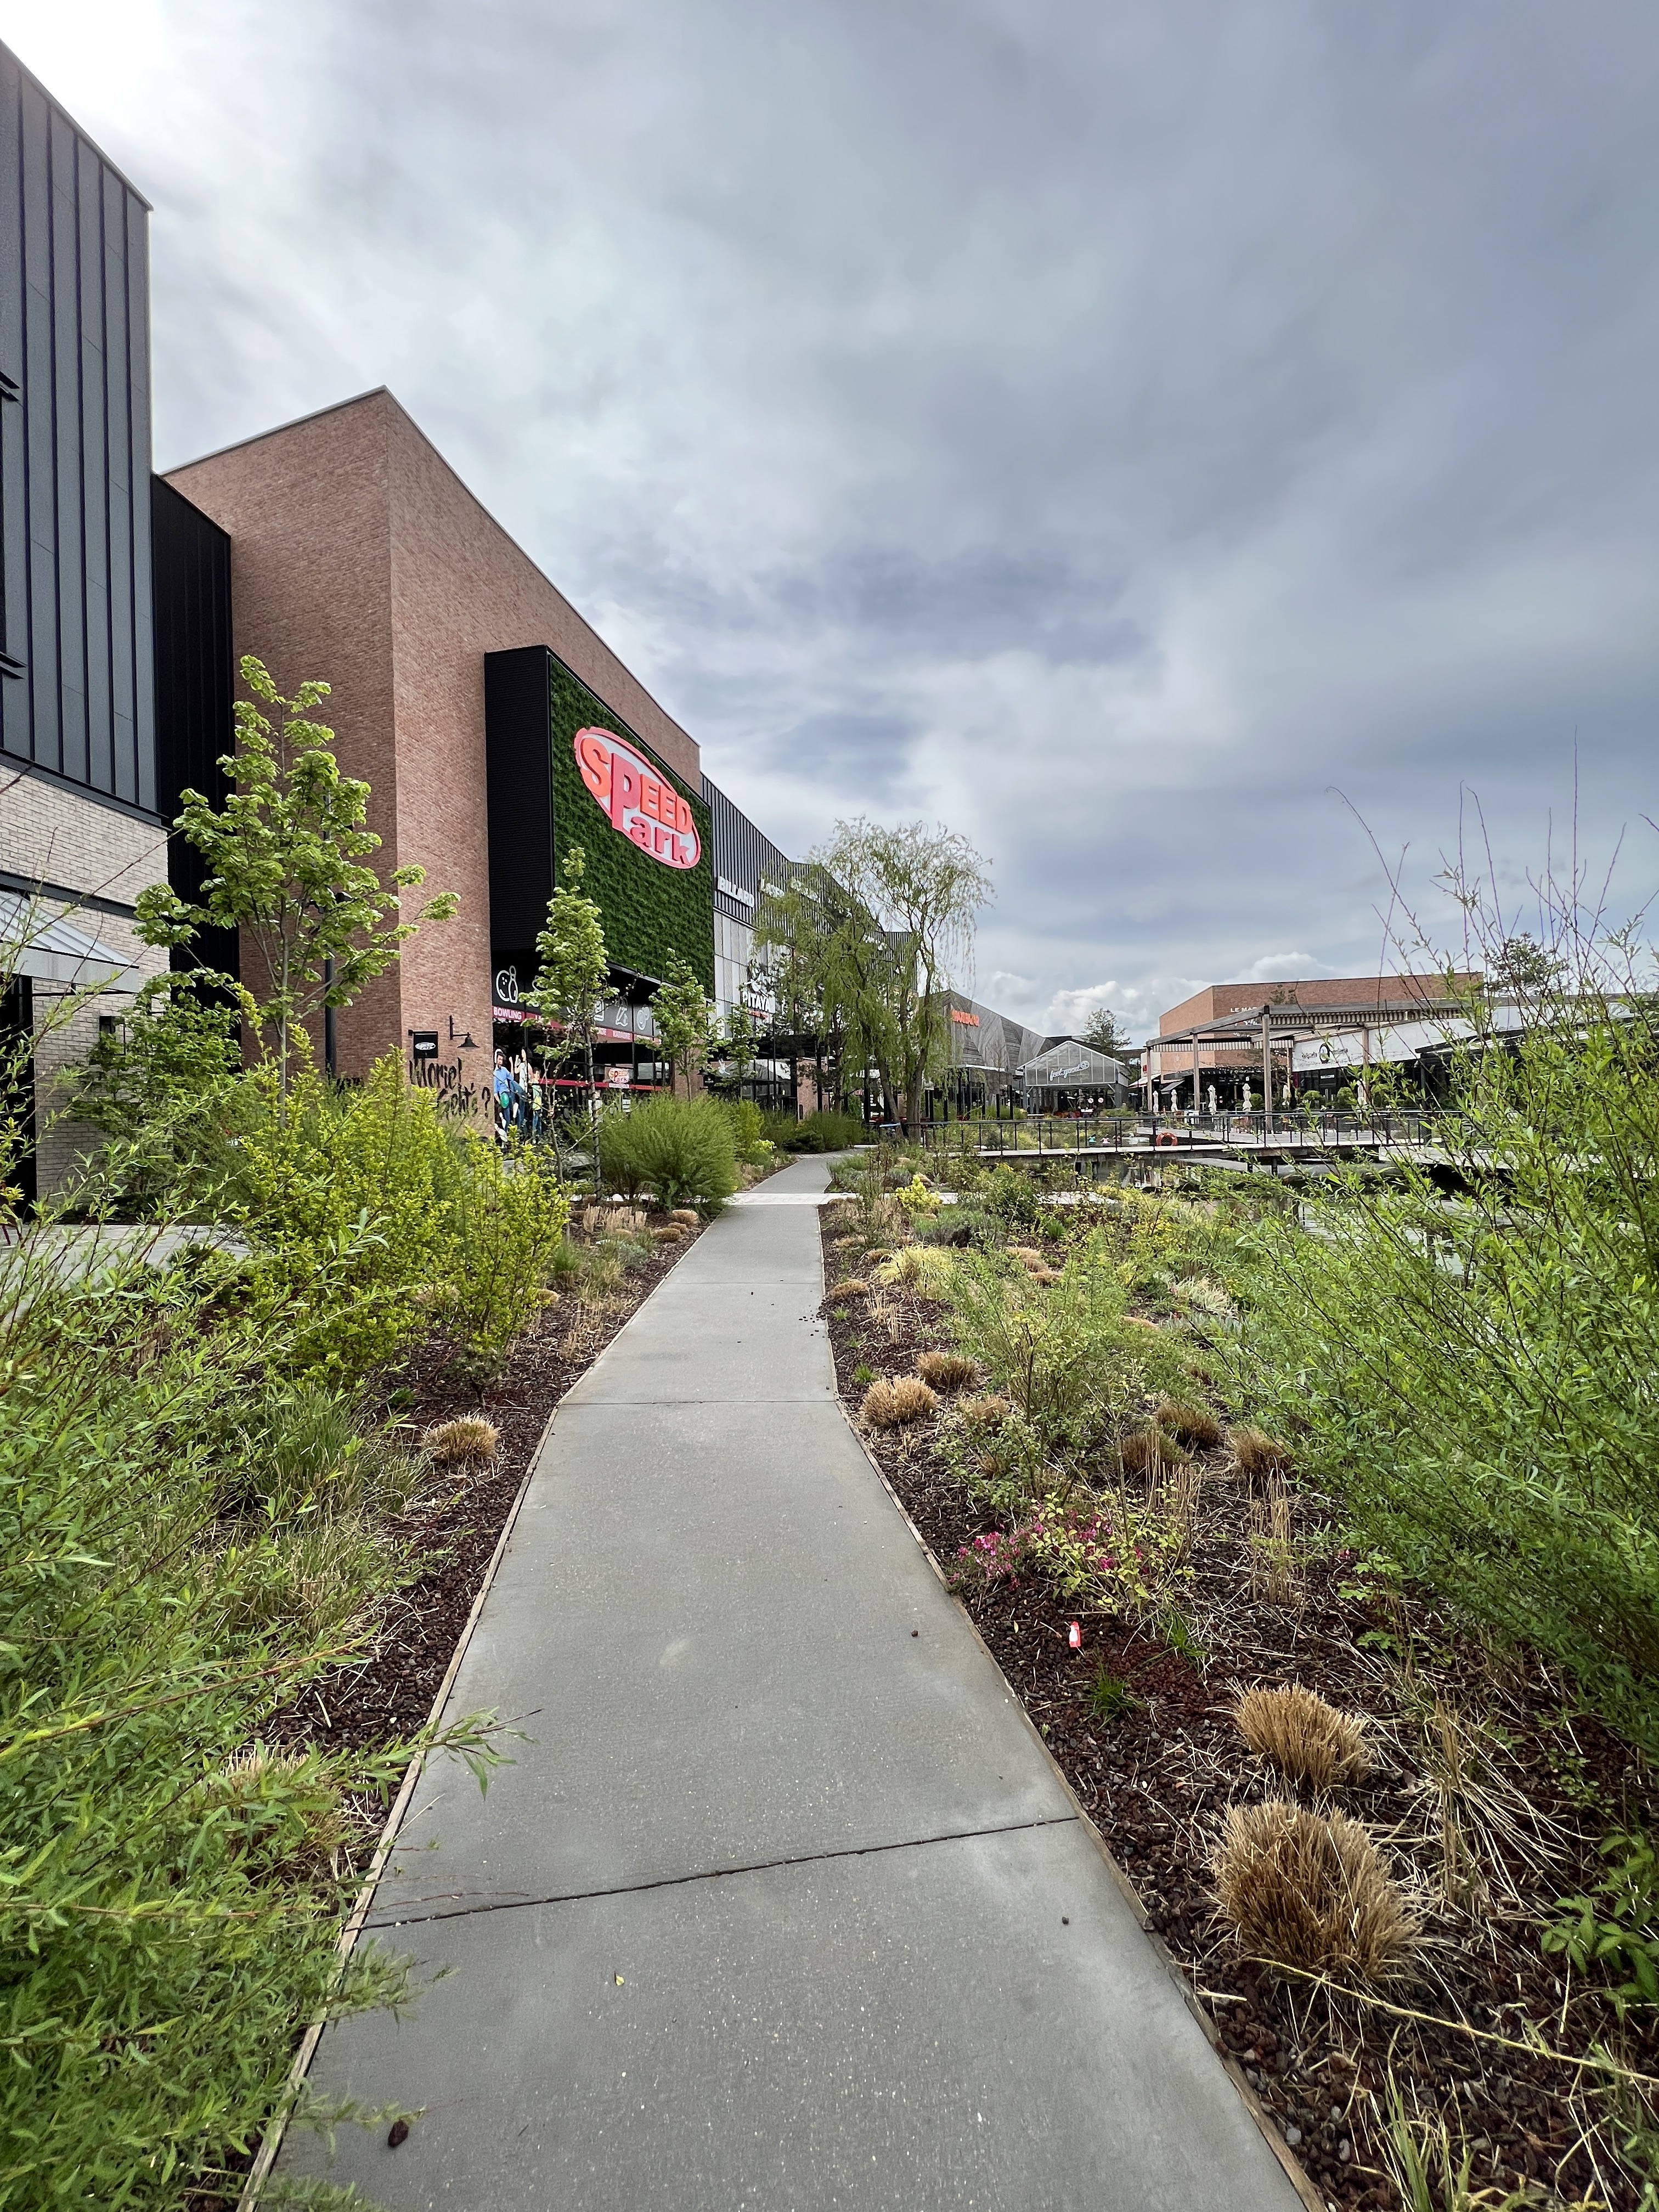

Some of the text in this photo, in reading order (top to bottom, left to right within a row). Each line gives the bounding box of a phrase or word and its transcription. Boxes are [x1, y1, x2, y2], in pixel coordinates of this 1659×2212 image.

[580, 738, 692, 834] SPEED
[718, 876, 754, 908] BILLARD
[494, 1006, 521, 1019] BOWLING
[742, 991, 770, 1013] PITAYA
